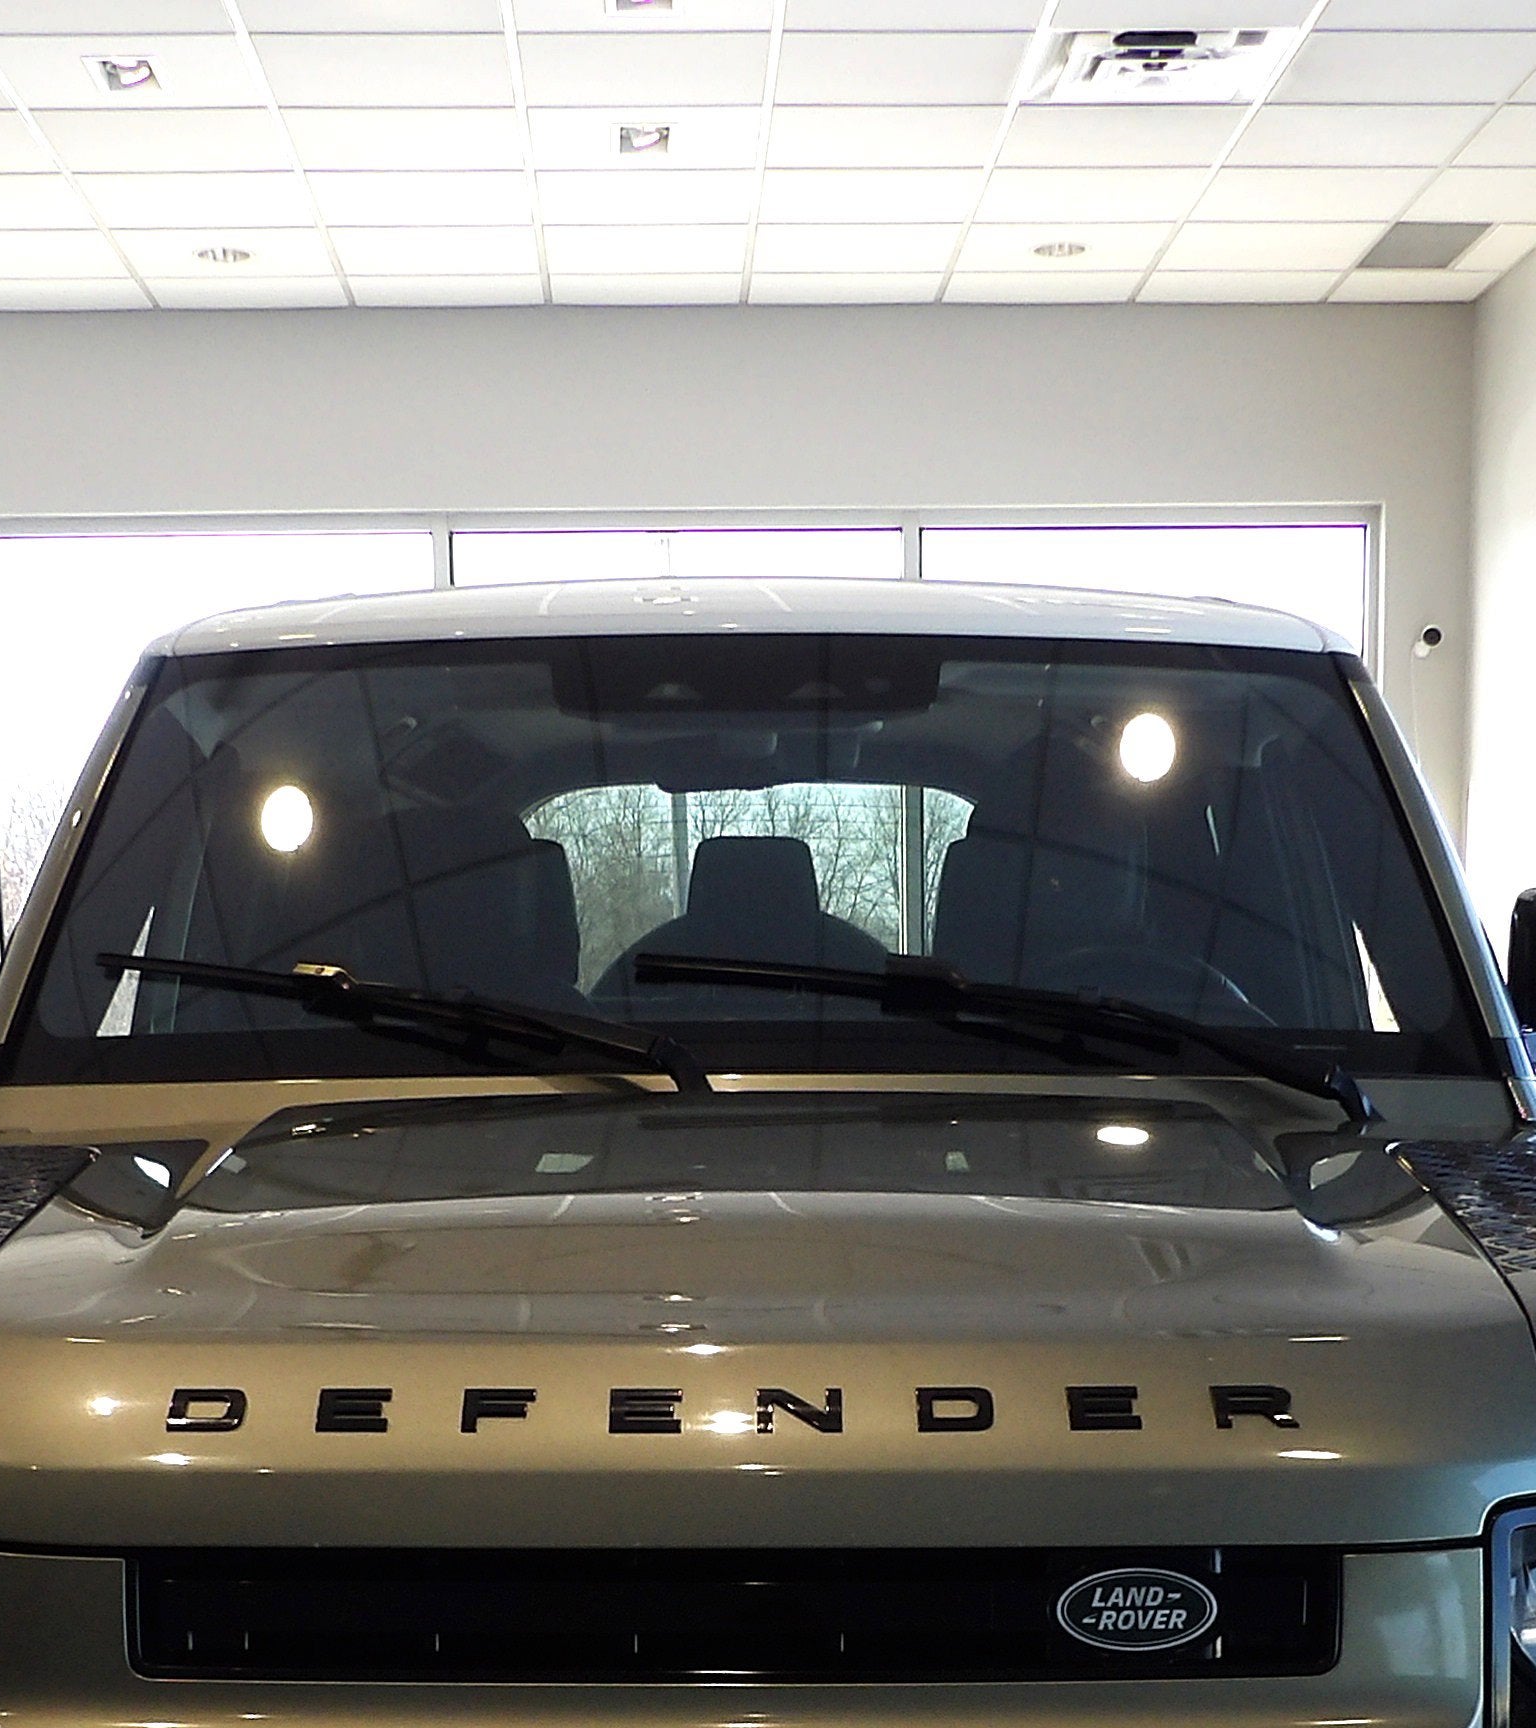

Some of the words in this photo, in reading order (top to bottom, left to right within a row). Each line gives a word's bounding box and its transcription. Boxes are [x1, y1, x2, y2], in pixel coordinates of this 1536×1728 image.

[166, 1385, 1300, 1433] DEFENDER
[1091, 1586, 1164, 1608] LAND
[1097, 1609, 1188, 1631] ROVER
